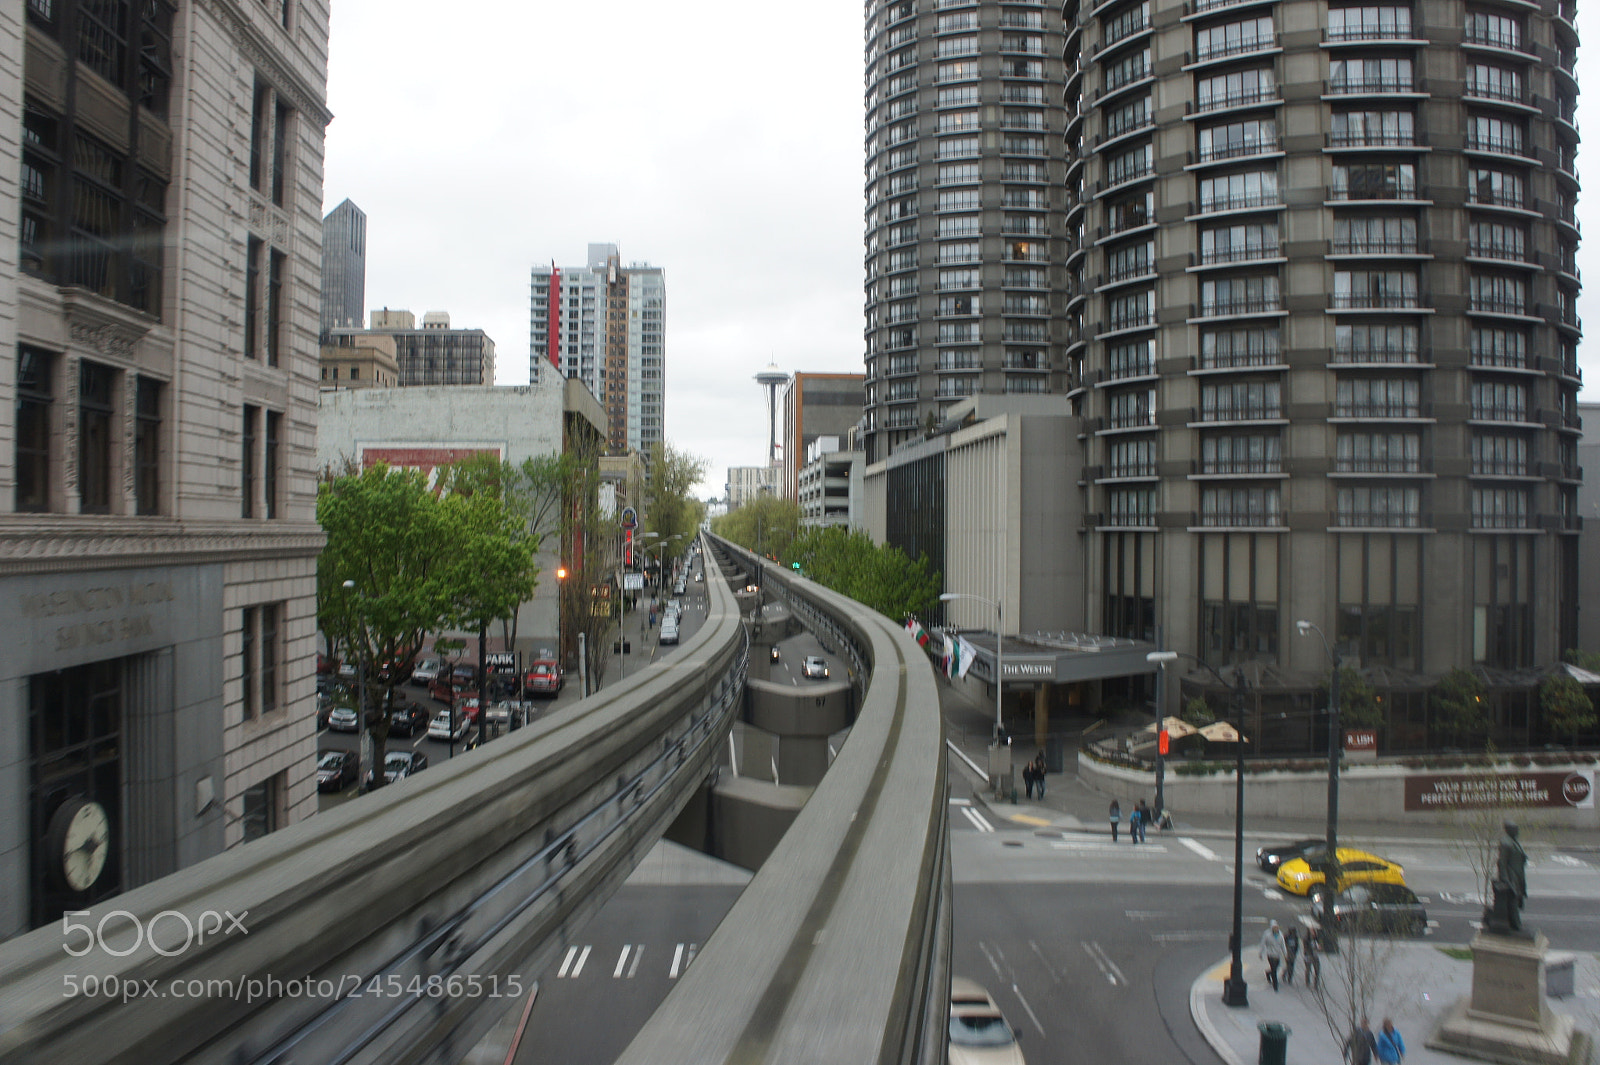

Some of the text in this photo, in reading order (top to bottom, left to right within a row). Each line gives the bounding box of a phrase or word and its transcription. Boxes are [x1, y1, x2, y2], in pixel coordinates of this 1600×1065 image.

[486, 654, 514, 665] PARK
[1003, 664, 1052, 674] THE WESTIN
[1433, 779, 1538, 792] YOUR SEARCH FOR THE
[1421, 792, 1460, 804] PERFECT
[1461, 791, 1498, 803] BURGER
[1525, 790, 1550, 801] HERE
